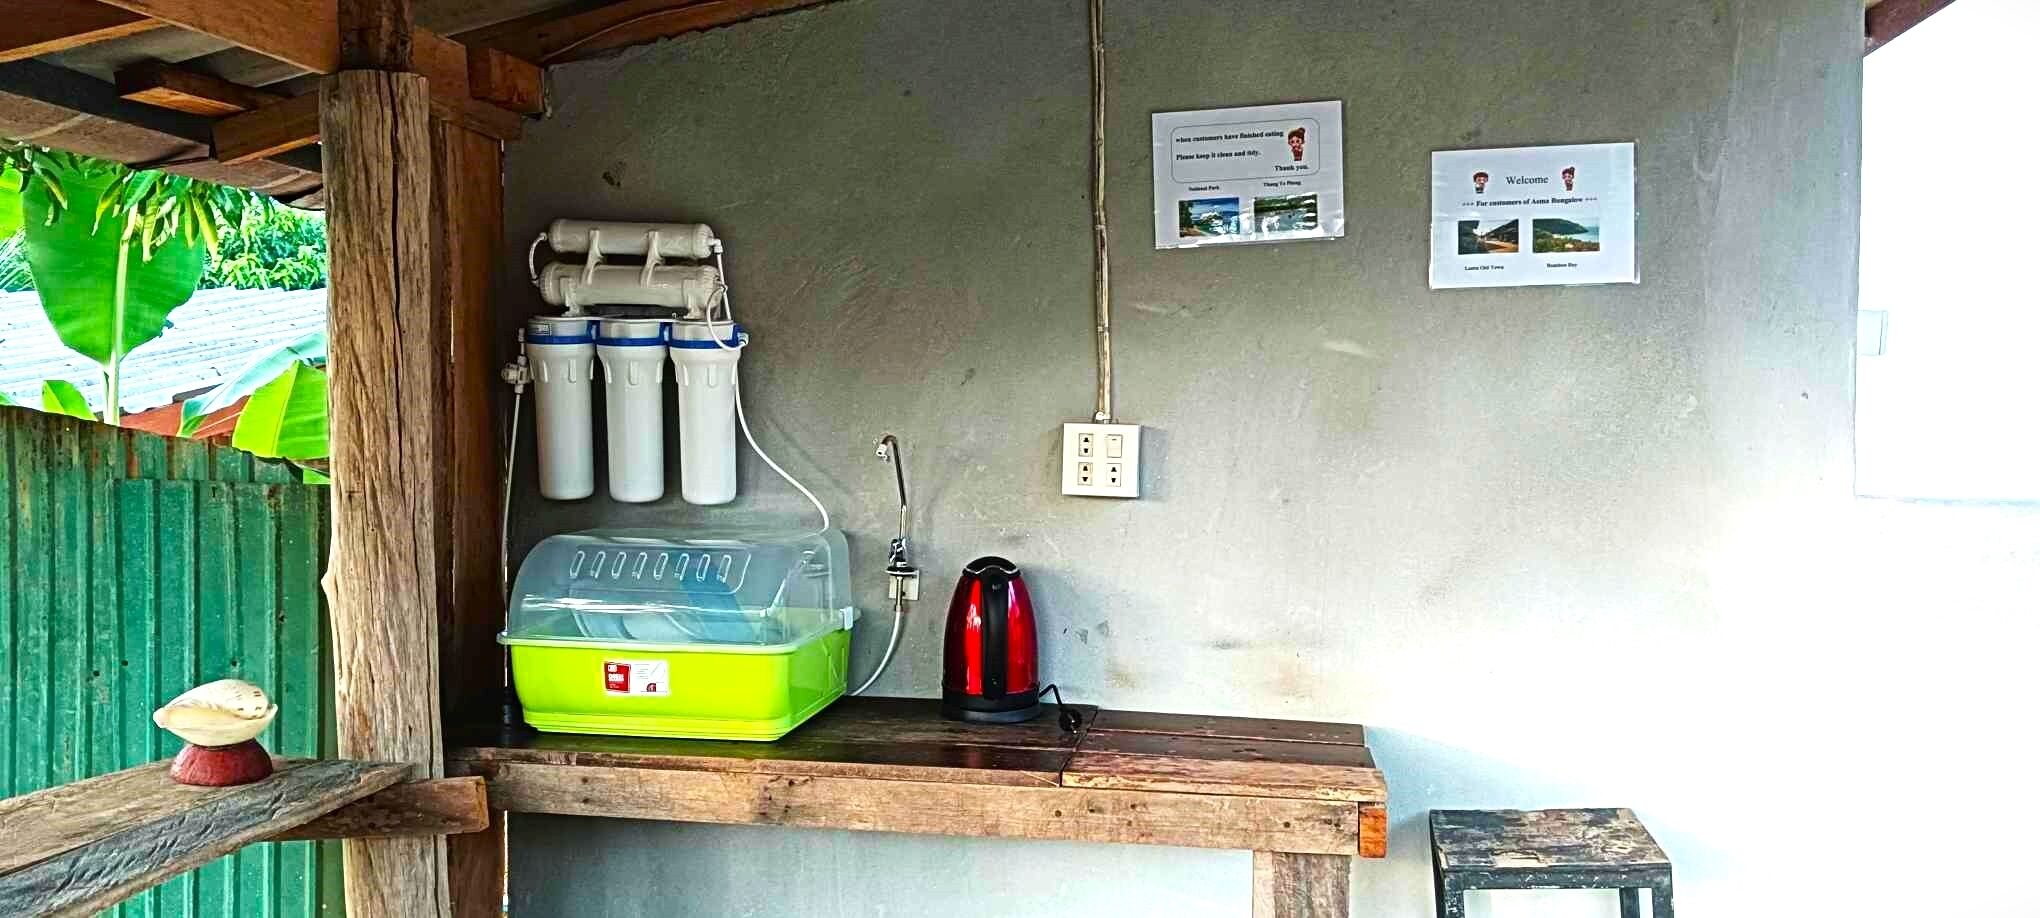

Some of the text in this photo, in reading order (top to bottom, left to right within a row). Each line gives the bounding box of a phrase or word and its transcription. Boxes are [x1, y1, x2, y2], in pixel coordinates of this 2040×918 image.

[1192, 134, 1223, 142] customers
[1224, 132, 1239, 140] have
[1176, 152, 1194, 161] Please
[1196, 150, 1210, 159] keep
[1505, 174, 1549, 185] Welcome
[1476, 200, 1487, 208] For
[1489, 199, 1522, 207] customers
[1523, 198, 1531, 206] of
[1551, 196, 1583, 205] Bungalow
